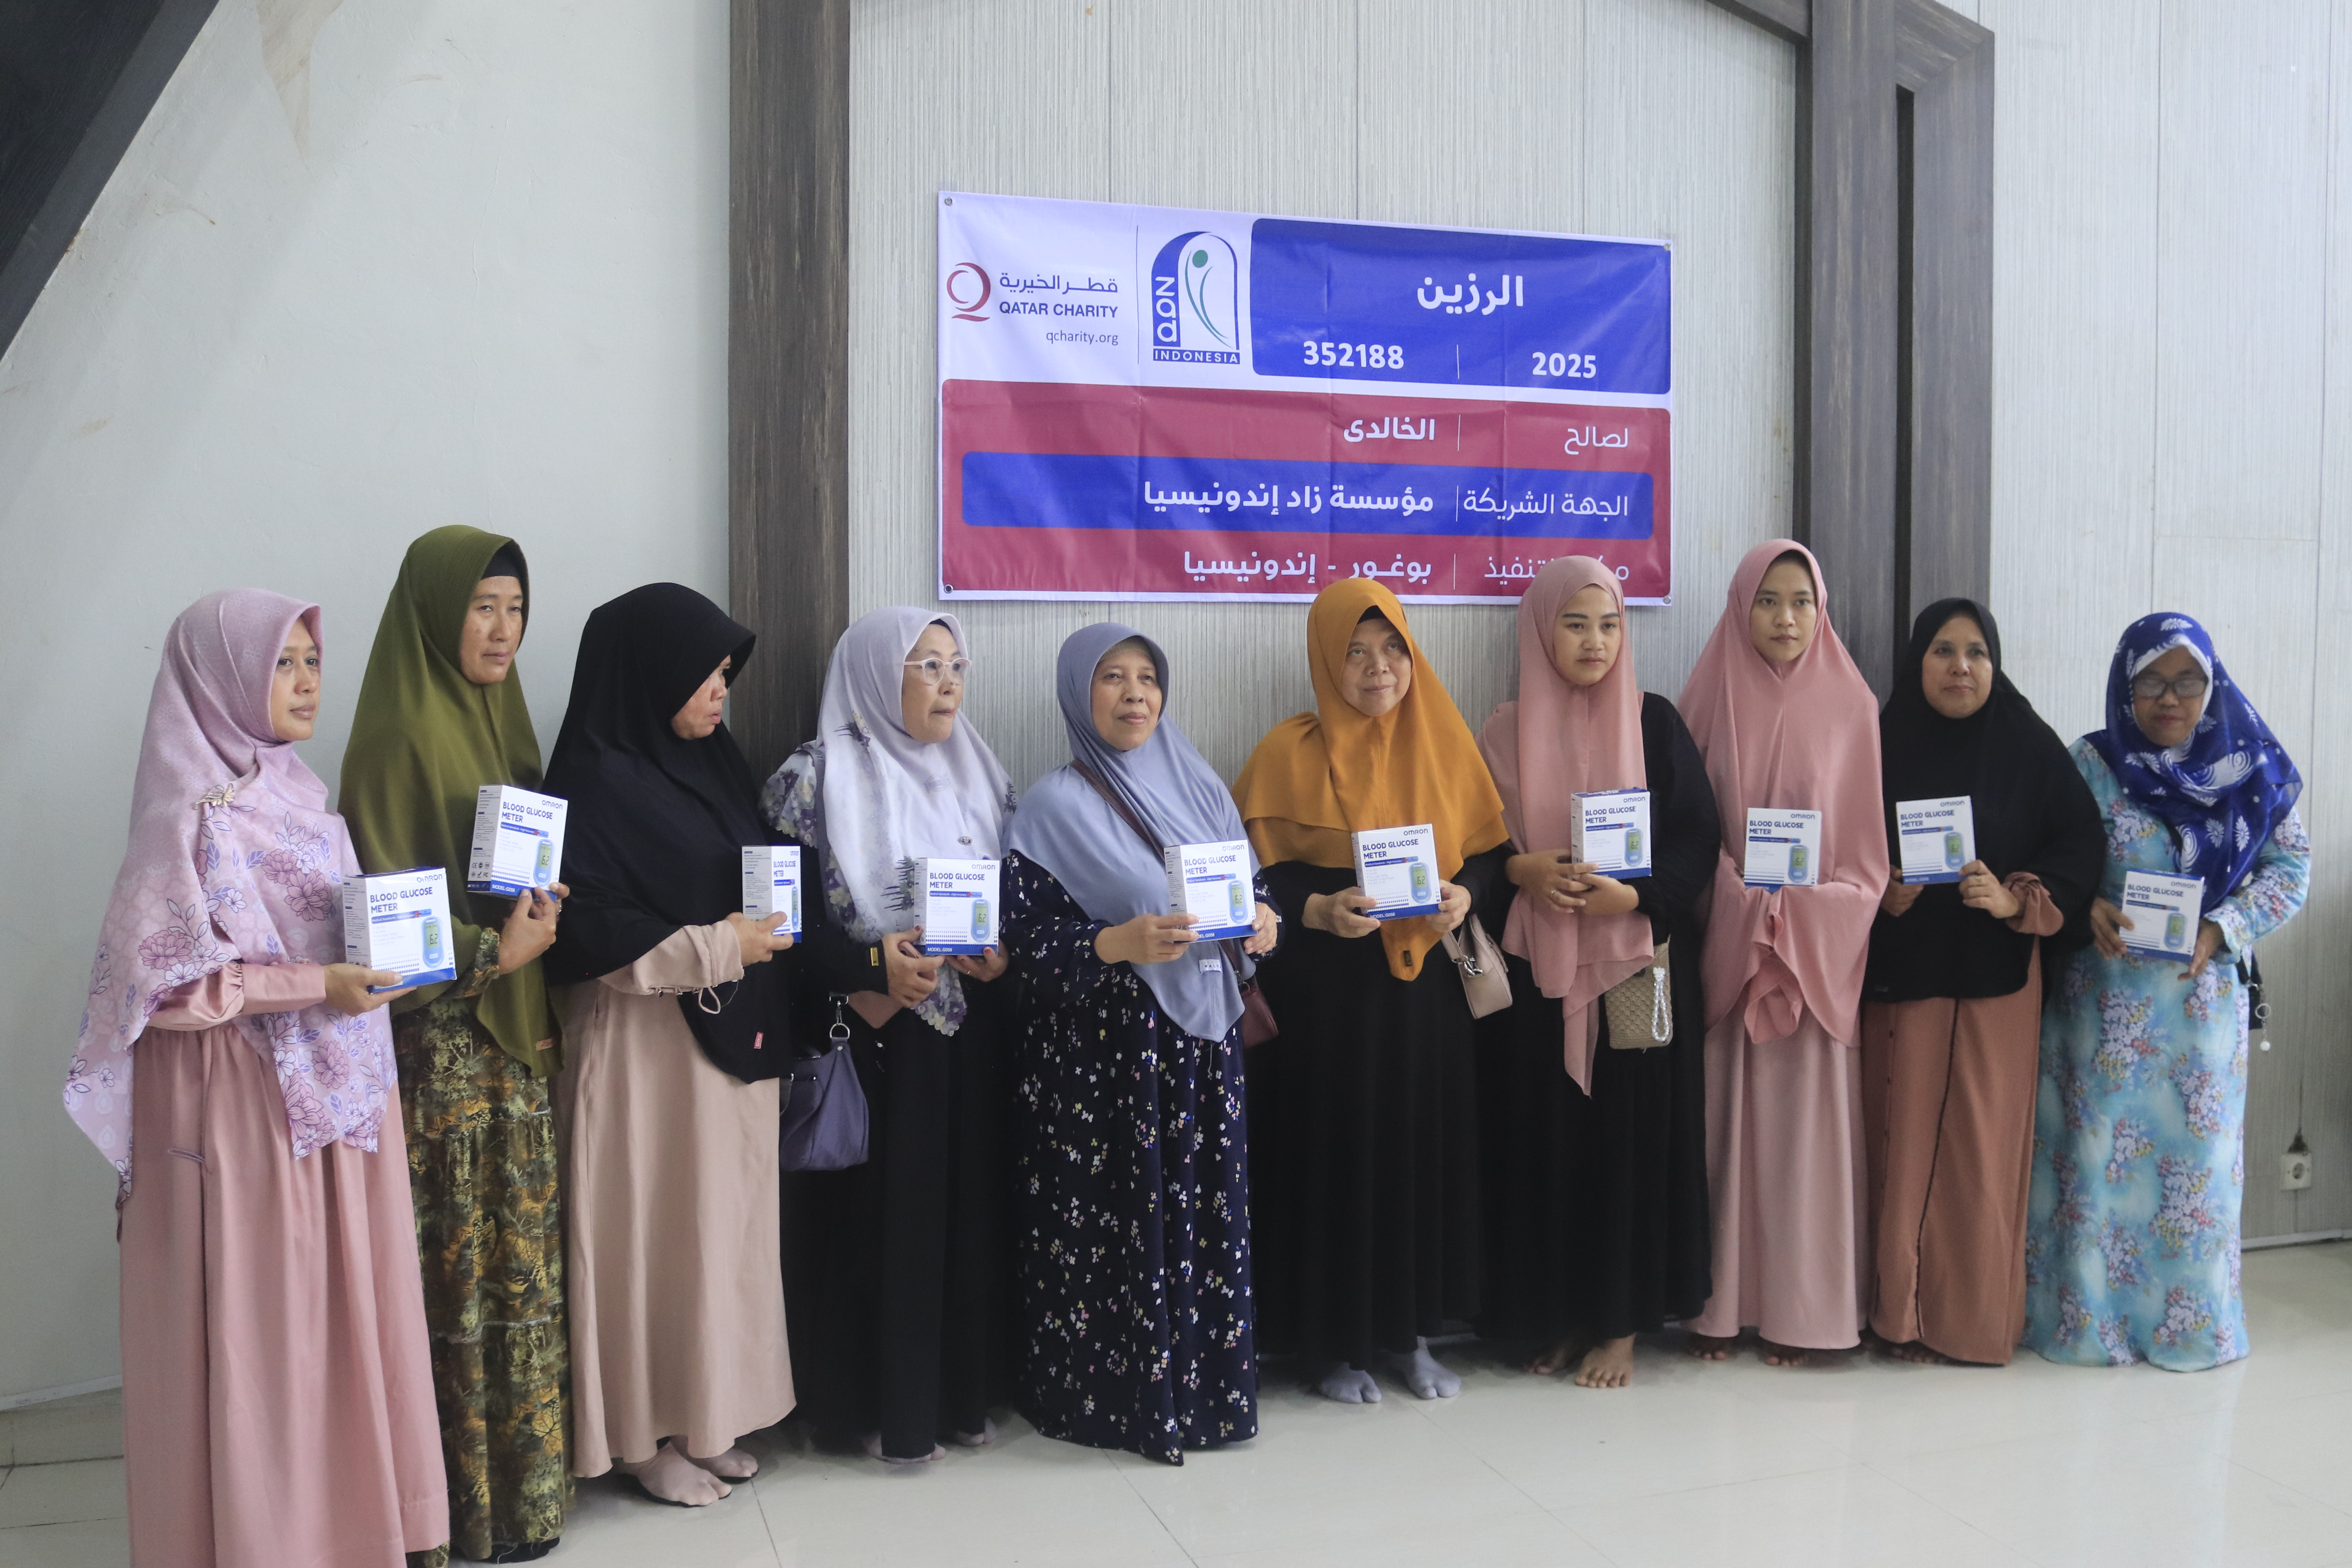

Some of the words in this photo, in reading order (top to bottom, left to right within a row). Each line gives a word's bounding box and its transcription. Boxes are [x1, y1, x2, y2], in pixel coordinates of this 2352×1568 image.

[1000, 272, 1060, 293] الخيرية
[1417, 273, 1523, 316] الرزين
[999, 301, 1048, 315] QATAR
[1053, 303, 1118, 318] CHARITY
[1046, 330, 1118, 346] qcharity.org
[1154, 350, 1239, 363] INDONESIA
[1303, 341, 1404, 369] 352188
[1532, 352, 1597, 378] 2025
[1564, 426, 1628, 455] لصالح
[1145, 481, 1279, 515] إندونيسيا
[1287, 486, 1322, 514] زاد
[1329, 485, 1433, 516] مؤسسة
[1464, 487, 1554, 521] الشريكة
[1561, 493, 1628, 521] الجهة
[1185, 551, 1316, 583] إندونيسيا
[1485, 557, 1555, 585] نفيذ
[502, 811, 523, 823] METER
[503, 802, 524, 813] BLOOD
[526, 807, 553, 819] GLUCOSE
[1363, 842, 1387, 851] BLOOD
[1388, 839, 1419, 848] GLUCOSE
[1184, 858, 1207, 866] BLOOD
[1209, 855, 1236, 864] GLUCOSE
[1363, 851, 1387, 859] METER
[370, 892, 397, 903] BLOOD
[400, 887, 433, 898] GLUCOSE
[2153, 888, 2183, 897] GLUCOSE
[371, 903, 398, 913] METER
